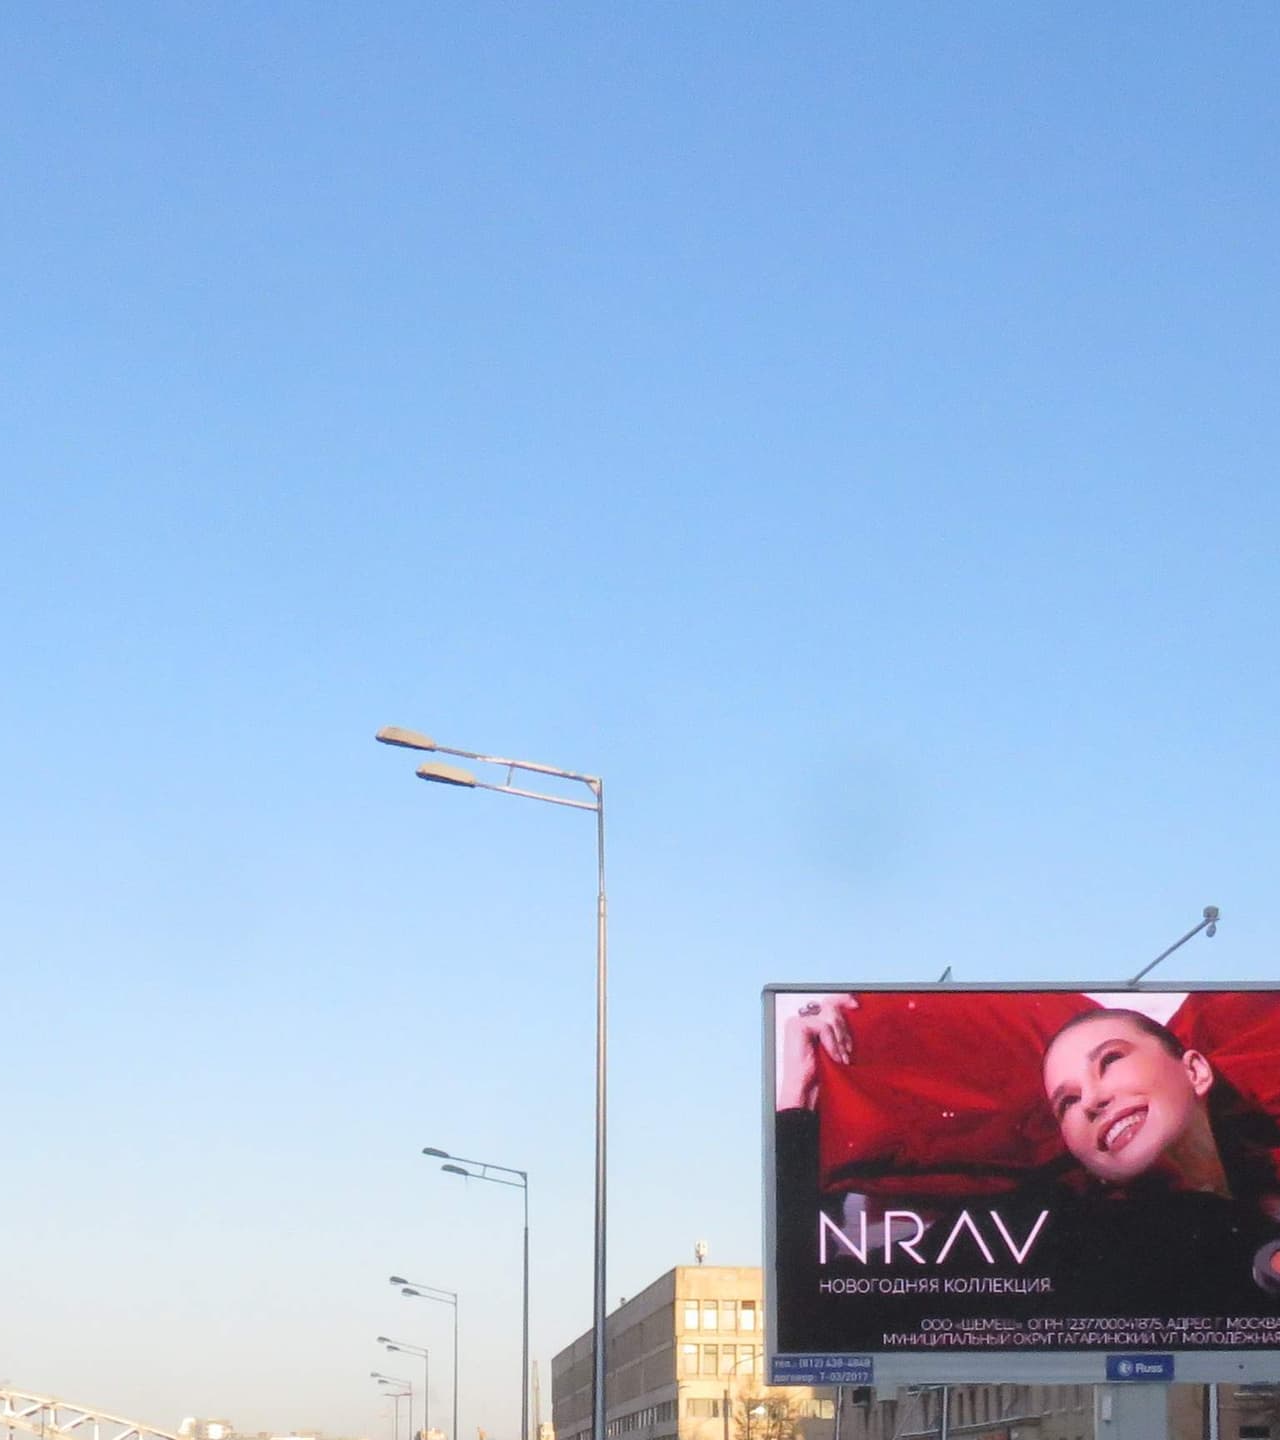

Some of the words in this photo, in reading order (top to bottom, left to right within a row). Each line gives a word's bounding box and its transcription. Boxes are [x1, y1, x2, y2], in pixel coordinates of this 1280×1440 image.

[819, 1210, 1050, 1265] NRAV
[820, 1278, 940, 1294] НОВОГОДНЯЯ
[944, 1277, 1052, 1294] КОЛЛЕКЦИЯ
[921, 1318, 953, 1331] ООО
[1135, 1362, 1164, 1374] Russ
